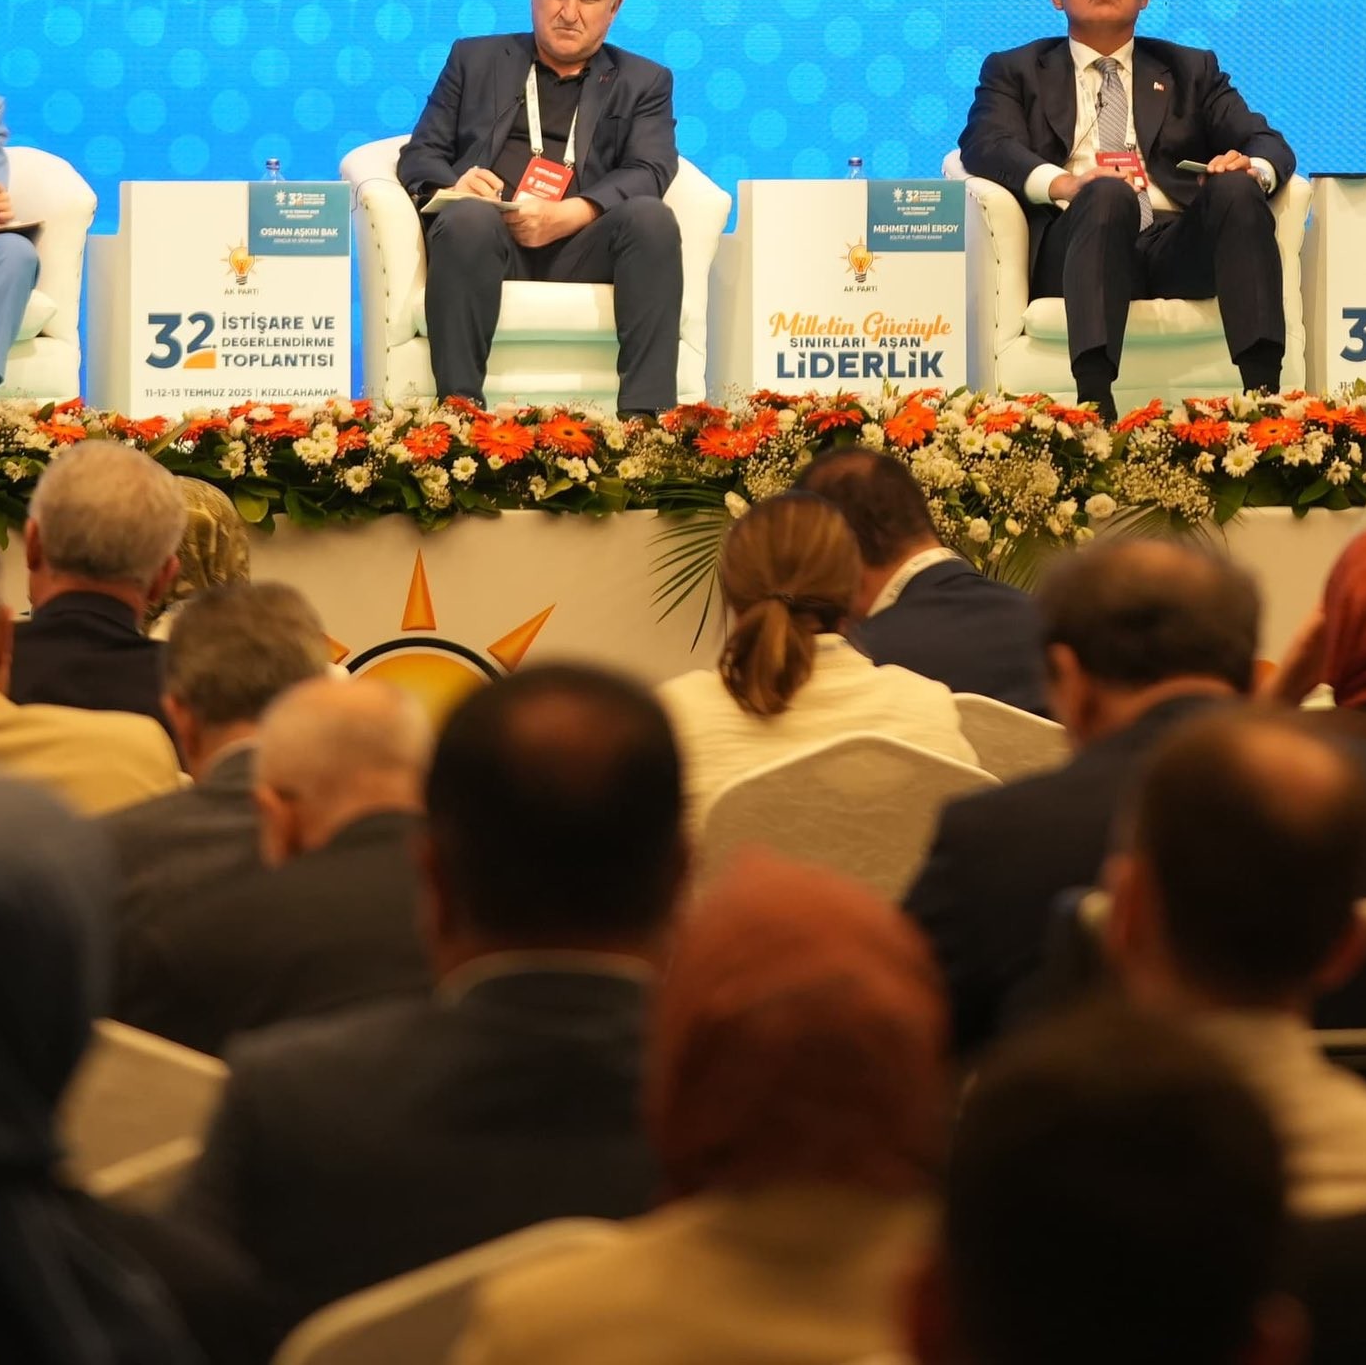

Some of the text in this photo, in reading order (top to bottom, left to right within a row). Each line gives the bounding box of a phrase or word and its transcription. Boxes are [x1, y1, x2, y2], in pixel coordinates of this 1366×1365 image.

[260, 227, 293, 236] OSMAN
[321, 227, 338, 236] BAK
[873, 223, 959, 233] MEHMET NURİ ERSOY
[222, 312, 335, 334] İSTİŞARE VE
[768, 310, 952, 342] Milletin Gücüyle
[790, 337, 921, 350] SINIRLARI AŞAN
[222, 353, 334, 367] TOPLANTISI
[145, 388, 181, 398] 11-12-13
[184, 387, 225, 398] TEMMUZ
[228, 387, 252, 398] 2025
